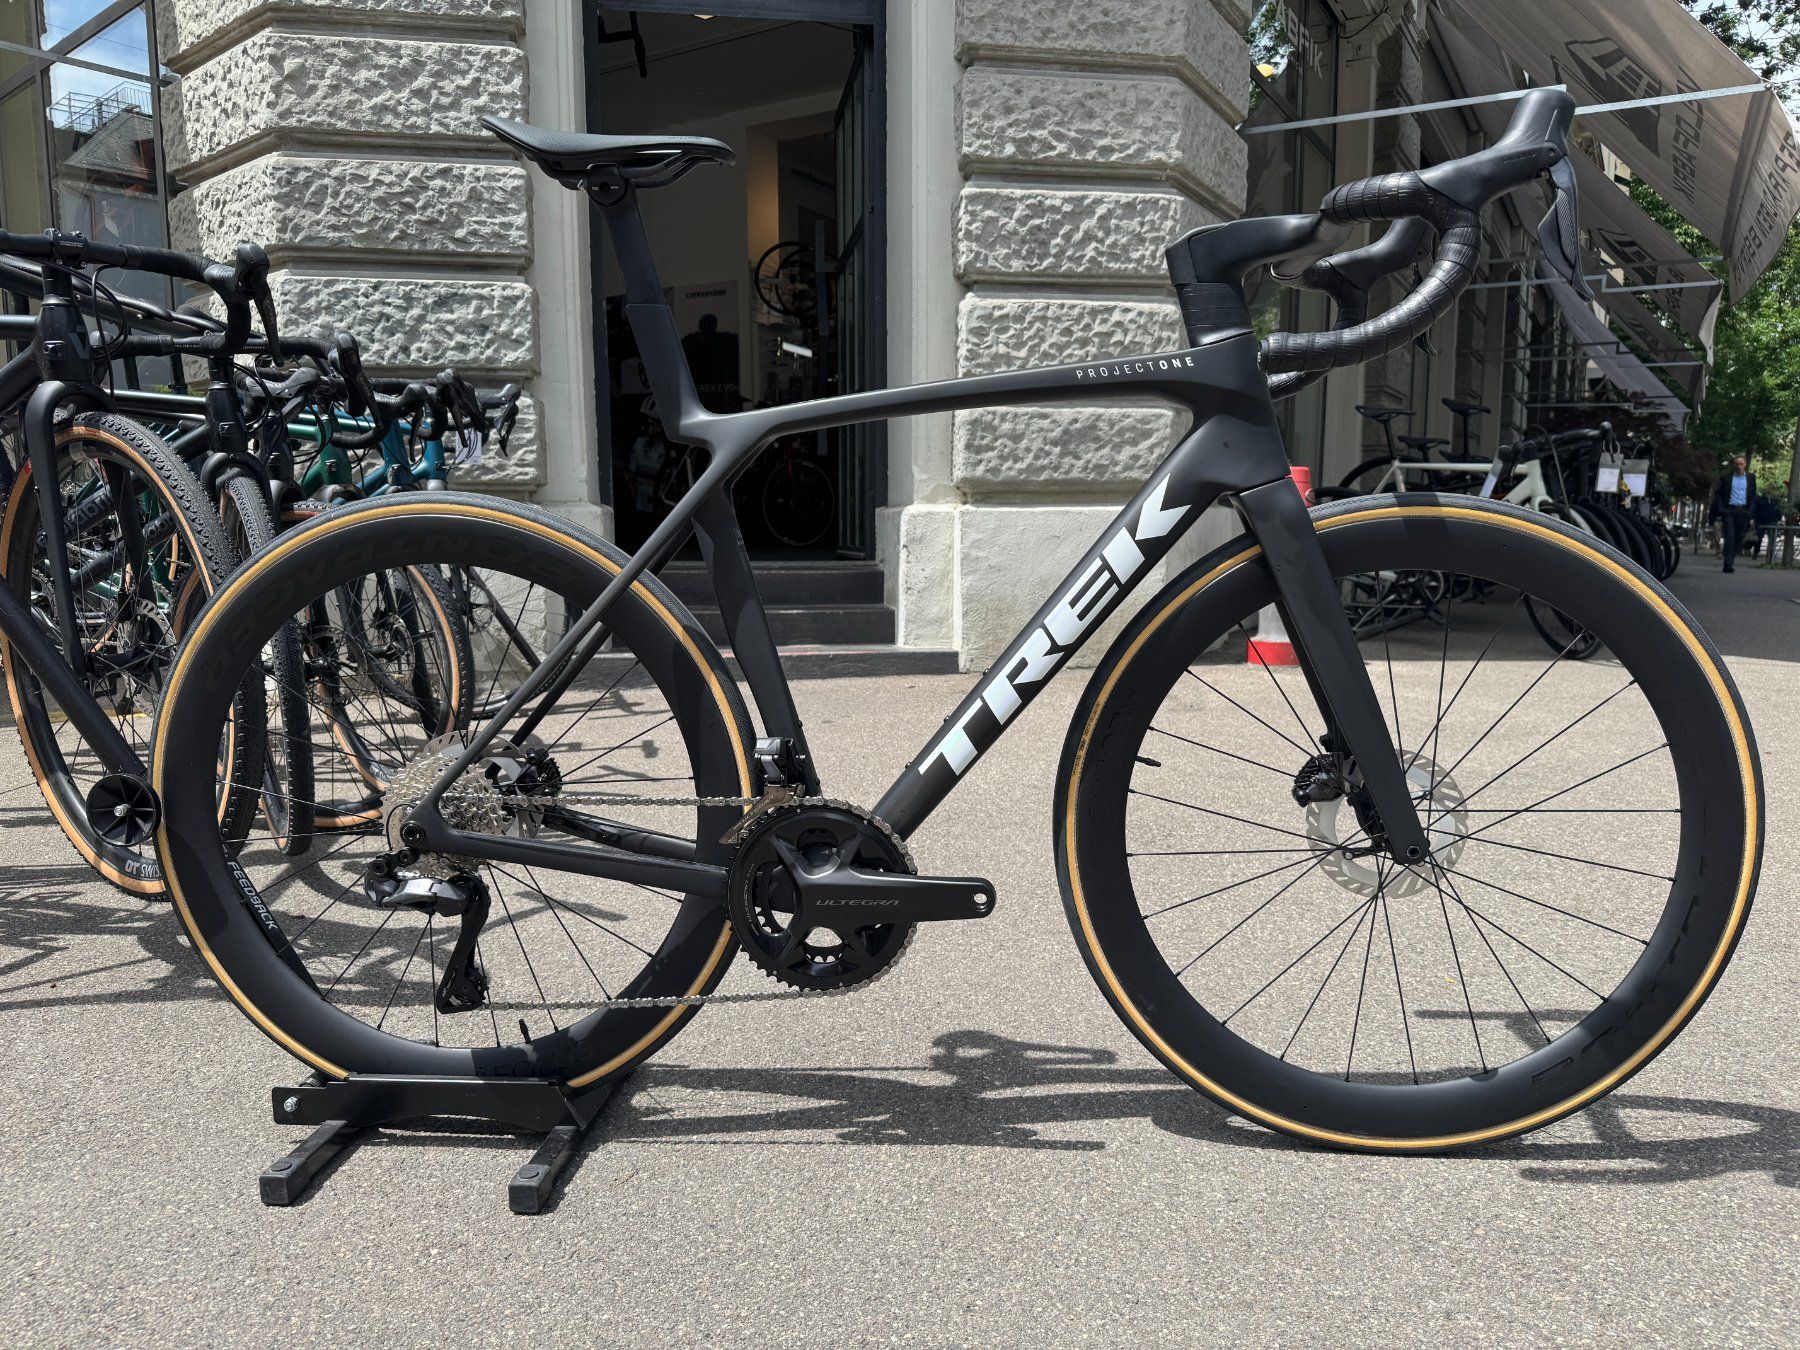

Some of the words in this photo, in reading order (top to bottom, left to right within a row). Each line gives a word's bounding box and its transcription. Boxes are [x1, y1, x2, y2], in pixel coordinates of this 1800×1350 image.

[1274, 0, 1323, 80] ABRIK
[918, 473, 1193, 777] TREK
[125, 859, 140, 875] DT
[140, 863, 162, 877] SWIS
[227, 861, 279, 930] FEEDBACK
